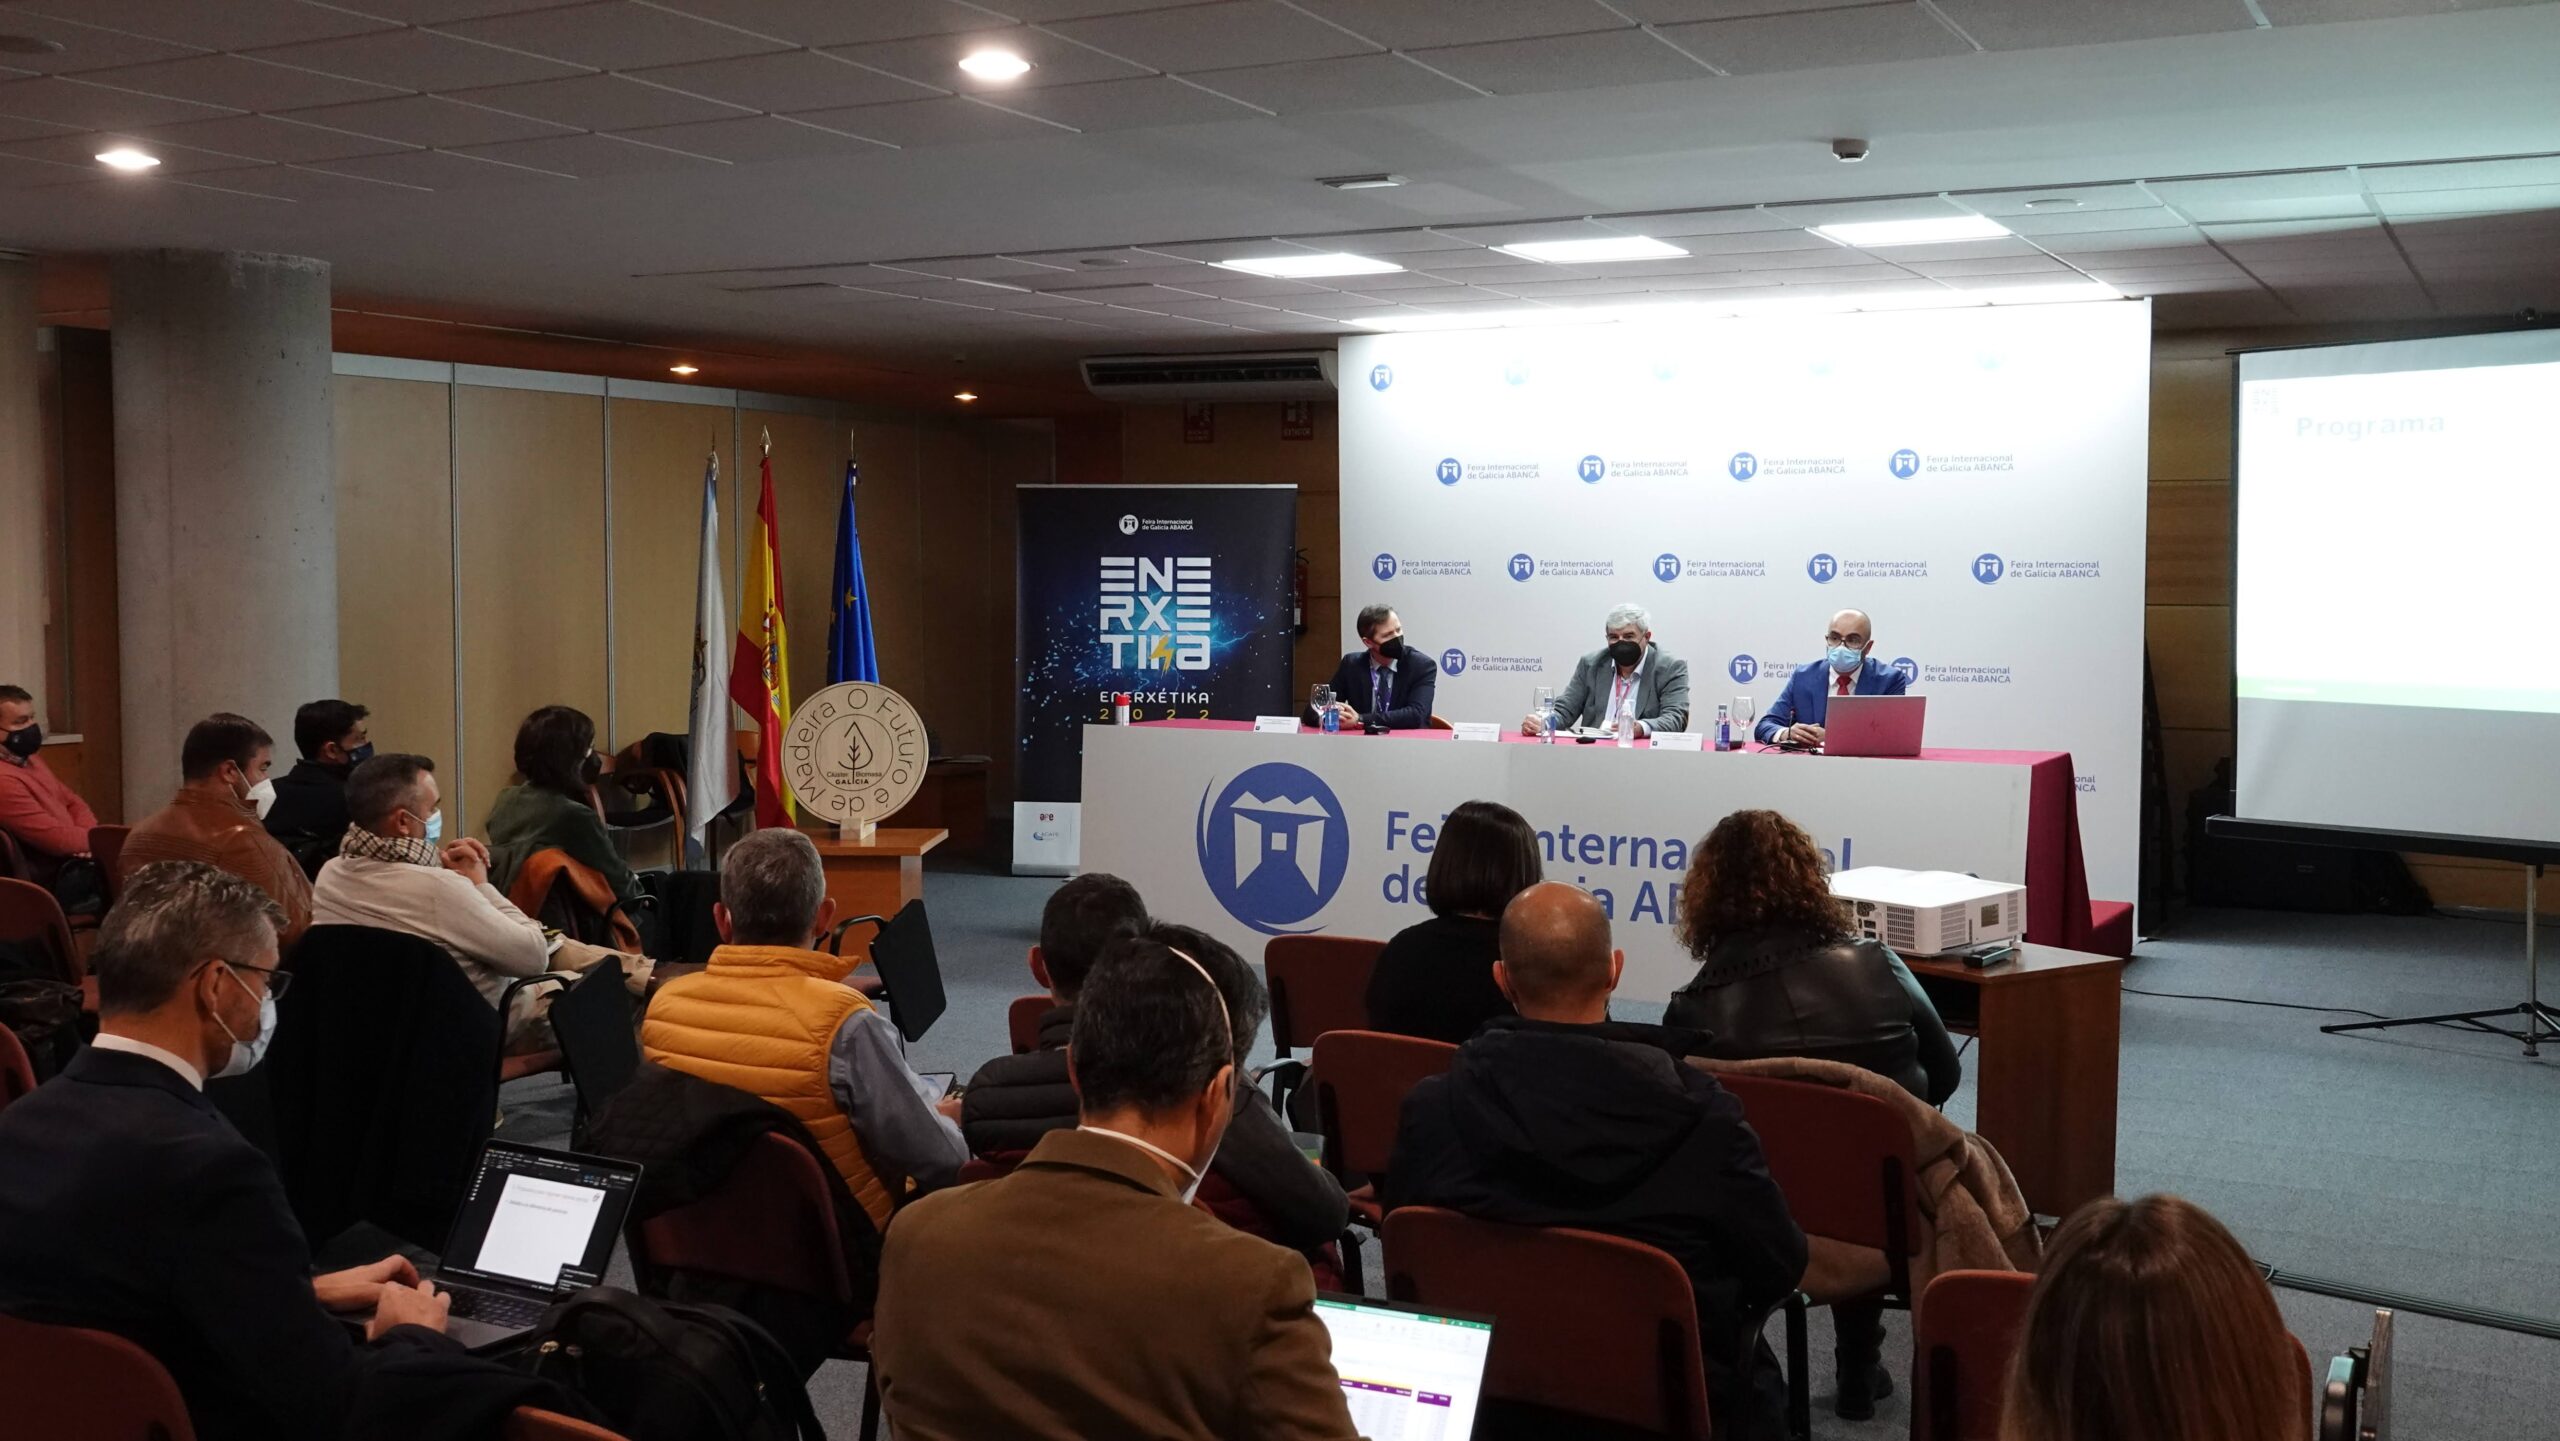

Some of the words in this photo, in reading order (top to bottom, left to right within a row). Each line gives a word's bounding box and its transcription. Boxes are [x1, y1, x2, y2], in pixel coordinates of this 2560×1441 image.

[2297, 416, 2446, 442] Programa
[1786, 457, 1844, 465] Internacional
[1951, 454, 2013, 462] Internacional
[1487, 463, 1539, 471] Internacional
[1632, 460, 1687, 468] Internacional
[1926, 464, 1938, 472] de
[1940, 463, 1971, 471] Galicia
[1973, 463, 2014, 471] ABANCA
[1623, 469, 1651, 477] Galicia
[1653, 468, 1688, 476] ABANCA
[1763, 467, 1774, 475] de
[1776, 466, 1806, 474] Galicia
[1808, 465, 1846, 473] ABANCA
[1467, 471, 1477, 479] de
[1478, 471, 1505, 479] Galicia
[1506, 471, 1540, 479] ABANCA
[1709, 560, 1765, 568] Internacional
[1843, 560, 1865, 568] Feira
[1867, 560, 1927, 568] Internacional
[2010, 560, 2033, 568] Feira
[2036, 560, 2100, 569] Internacional
[1439, 568, 1472, 576] ABANCA
[1539, 568, 1550, 576] de
[1551, 568, 1579, 576] Galicia
[1580, 568, 1614, 576] ABANCA
[1699, 568, 1728, 576] Galicia
[1729, 569, 1766, 577] ABANCA
[1843, 569, 1855, 577] de
[1856, 569, 1887, 577] Galicia
[1889, 569, 1928, 577] ABANCA
[2010, 569, 2022, 577] de
[2024, 569, 2057, 578] Galicia
[2059, 569, 2101, 577] ABANCA
[1471, 655, 1490, 663] Feira
[1491, 655, 1542, 664] Internacional
[1482, 664, 1509, 672] Galicia
[1510, 664, 1543, 672] ABANCA
[1764, 662, 1784, 670] Feira
[1924, 665, 1947, 673] Feira
[1949, 665, 2010, 674] Internacional
[1924, 674, 1937, 682] de
[1938, 674, 1969, 683] Galicia
[1970, 674, 2011, 684] ABANCA
[848, 688, 868, 709] O
[876, 697, 916, 785] Futuro
[789, 702, 836, 803] Madeira
[831, 795, 865, 816] de
